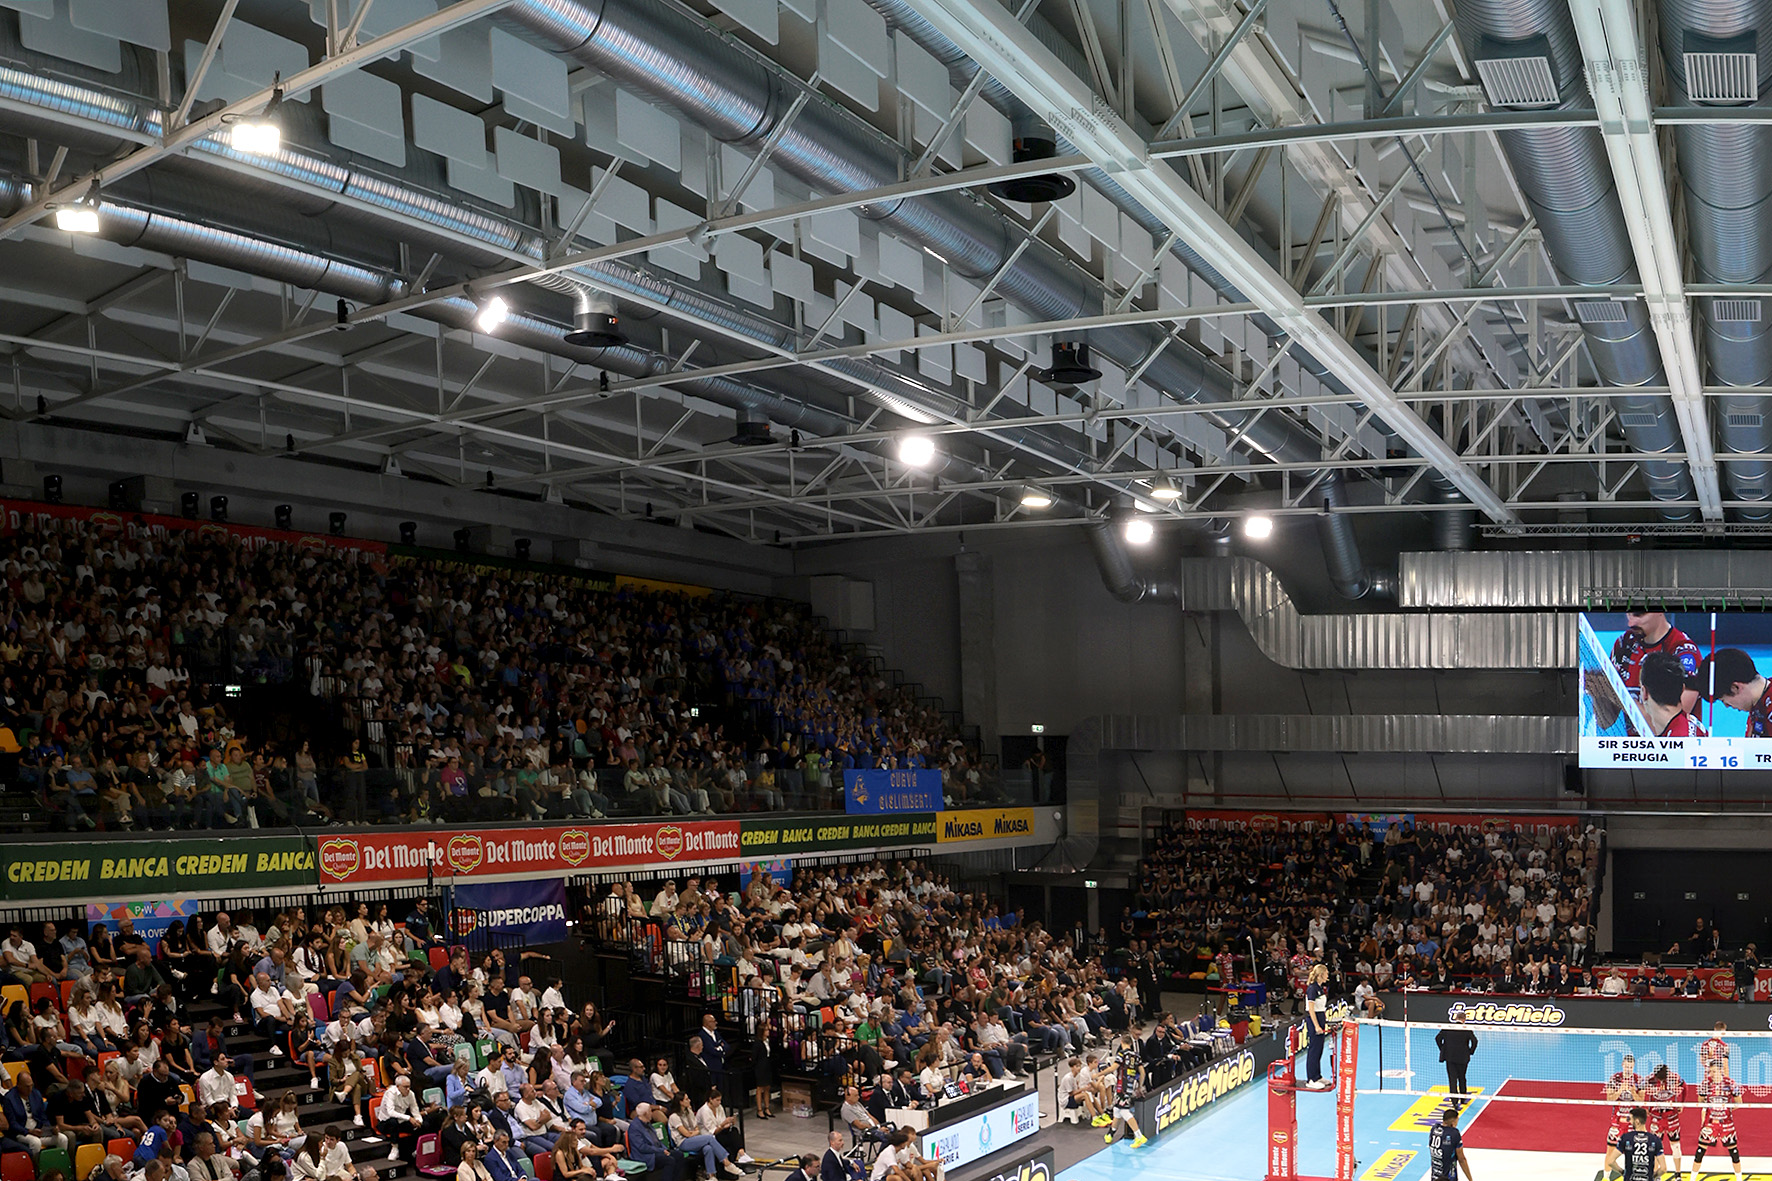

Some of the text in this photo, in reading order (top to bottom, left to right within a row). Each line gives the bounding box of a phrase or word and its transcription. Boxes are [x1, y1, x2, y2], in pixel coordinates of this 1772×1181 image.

[1598, 740, 1683, 750] SIR SUSA VIM
[1612, 753, 1668, 762] PERUGIA
[1690, 756, 1708, 767] 12
[1720, 756, 1738, 768] 16
[741, 828, 813, 846] CREDEM BANCA
[817, 825, 880, 841] CREDEM BANCA
[880, 822, 936, 837] CREDEM BANCA
[592, 834, 654, 857] Del Monte
[685, 829, 739, 852] Del Monte
[324, 850, 356, 862] Del Monte
[364, 845, 391, 870] Del
[486, 838, 556, 864] Del Monte
[8, 856, 169, 883] CREDEM BANCA
[175, 850, 315, 876] CREDEM BANCA
[478, 903, 565, 928] SUPERCOPPA
[1159, 1055, 1253, 1131] LatteMiele
[1431, 1136, 1441, 1149] 10
[1634, 1142, 1648, 1155] 23
[1632, 1155, 1649, 1163] ITAS
